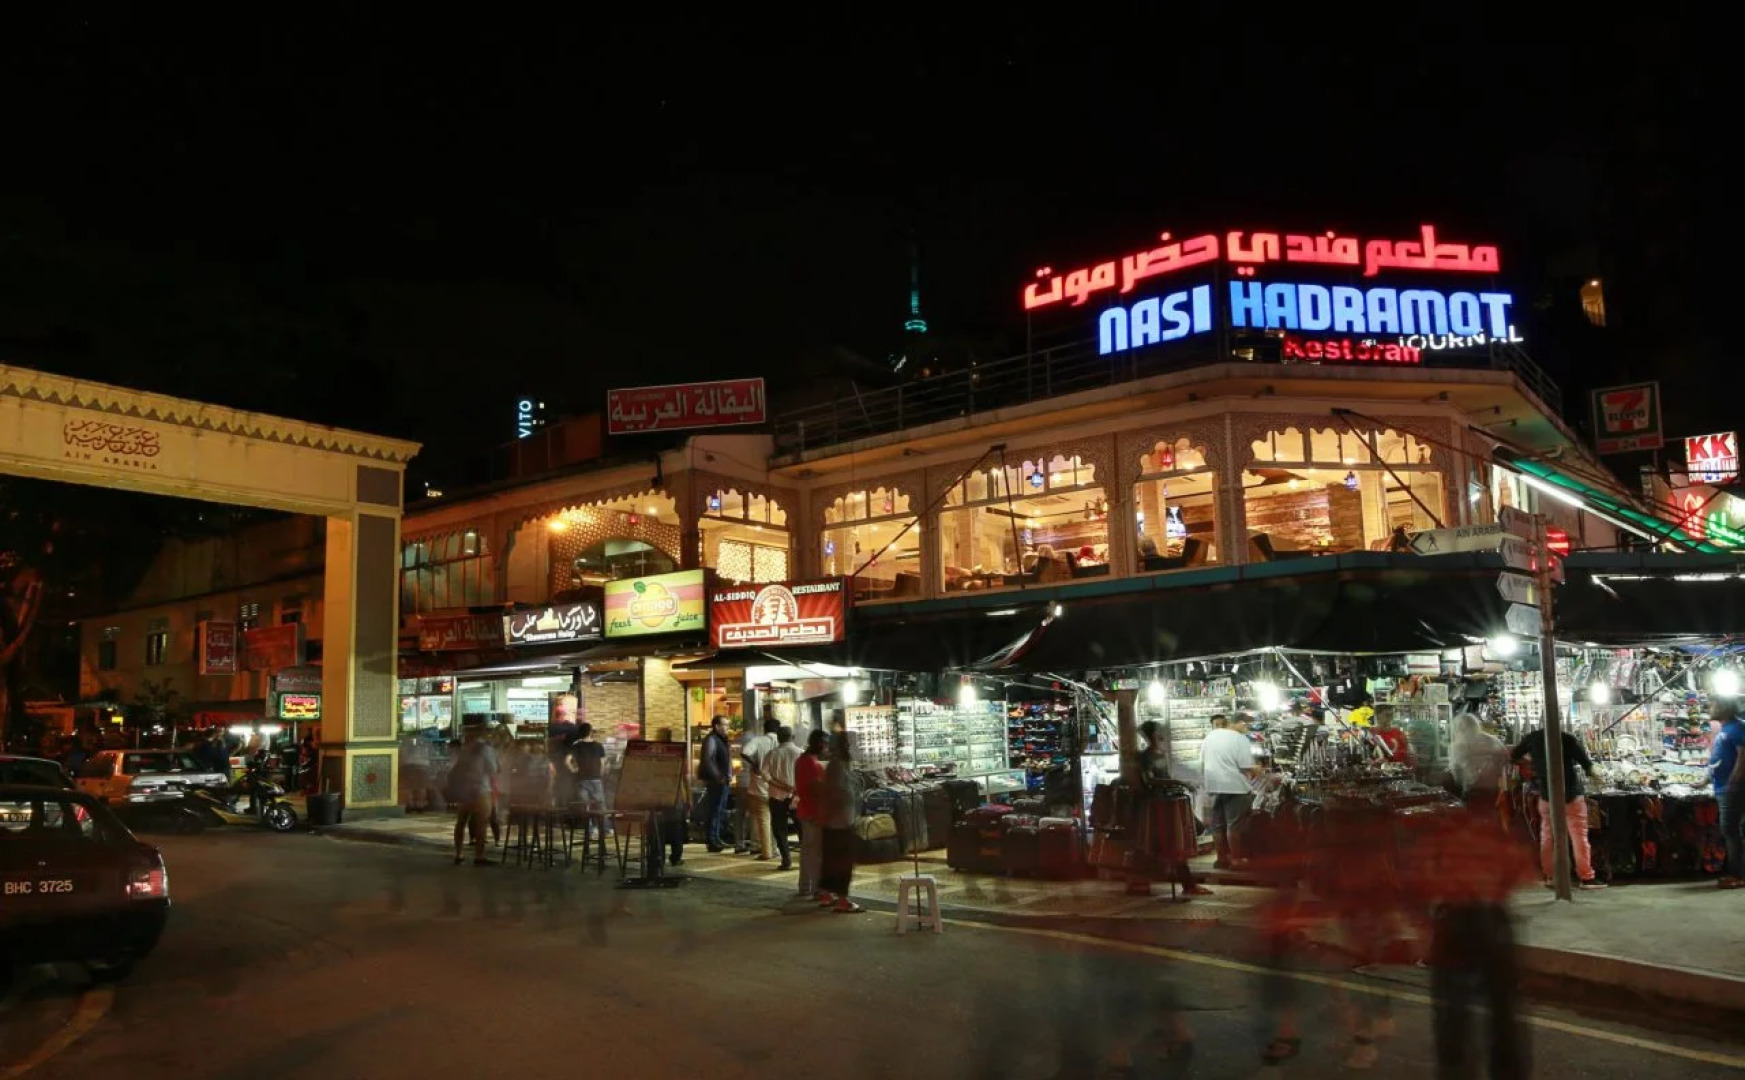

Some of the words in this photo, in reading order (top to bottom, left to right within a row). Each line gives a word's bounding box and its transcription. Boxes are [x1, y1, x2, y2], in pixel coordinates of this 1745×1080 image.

[1364, 224, 1501, 276] مطعم
[1025, 231, 1219, 310] حضرموت
[1099, 283, 1212, 356] NASI
[1229, 279, 1512, 338] HADRAMOT
[518, 400, 533, 439] VITO
[611, 388, 688, 430] العربية
[693, 382, 763, 422] البقالة
[65, 450, 91, 460] AIN
[103, 456, 157, 470] ARABIA
[1688, 433, 1734, 462] KK
[714, 591, 756, 602] AL-SIDDIQ
[792, 581, 841, 595] RESTAURANT
[780, 622, 827, 639] مطعم
[4, 881, 34, 895] BHC
[38, 879, 74, 894] 3725
